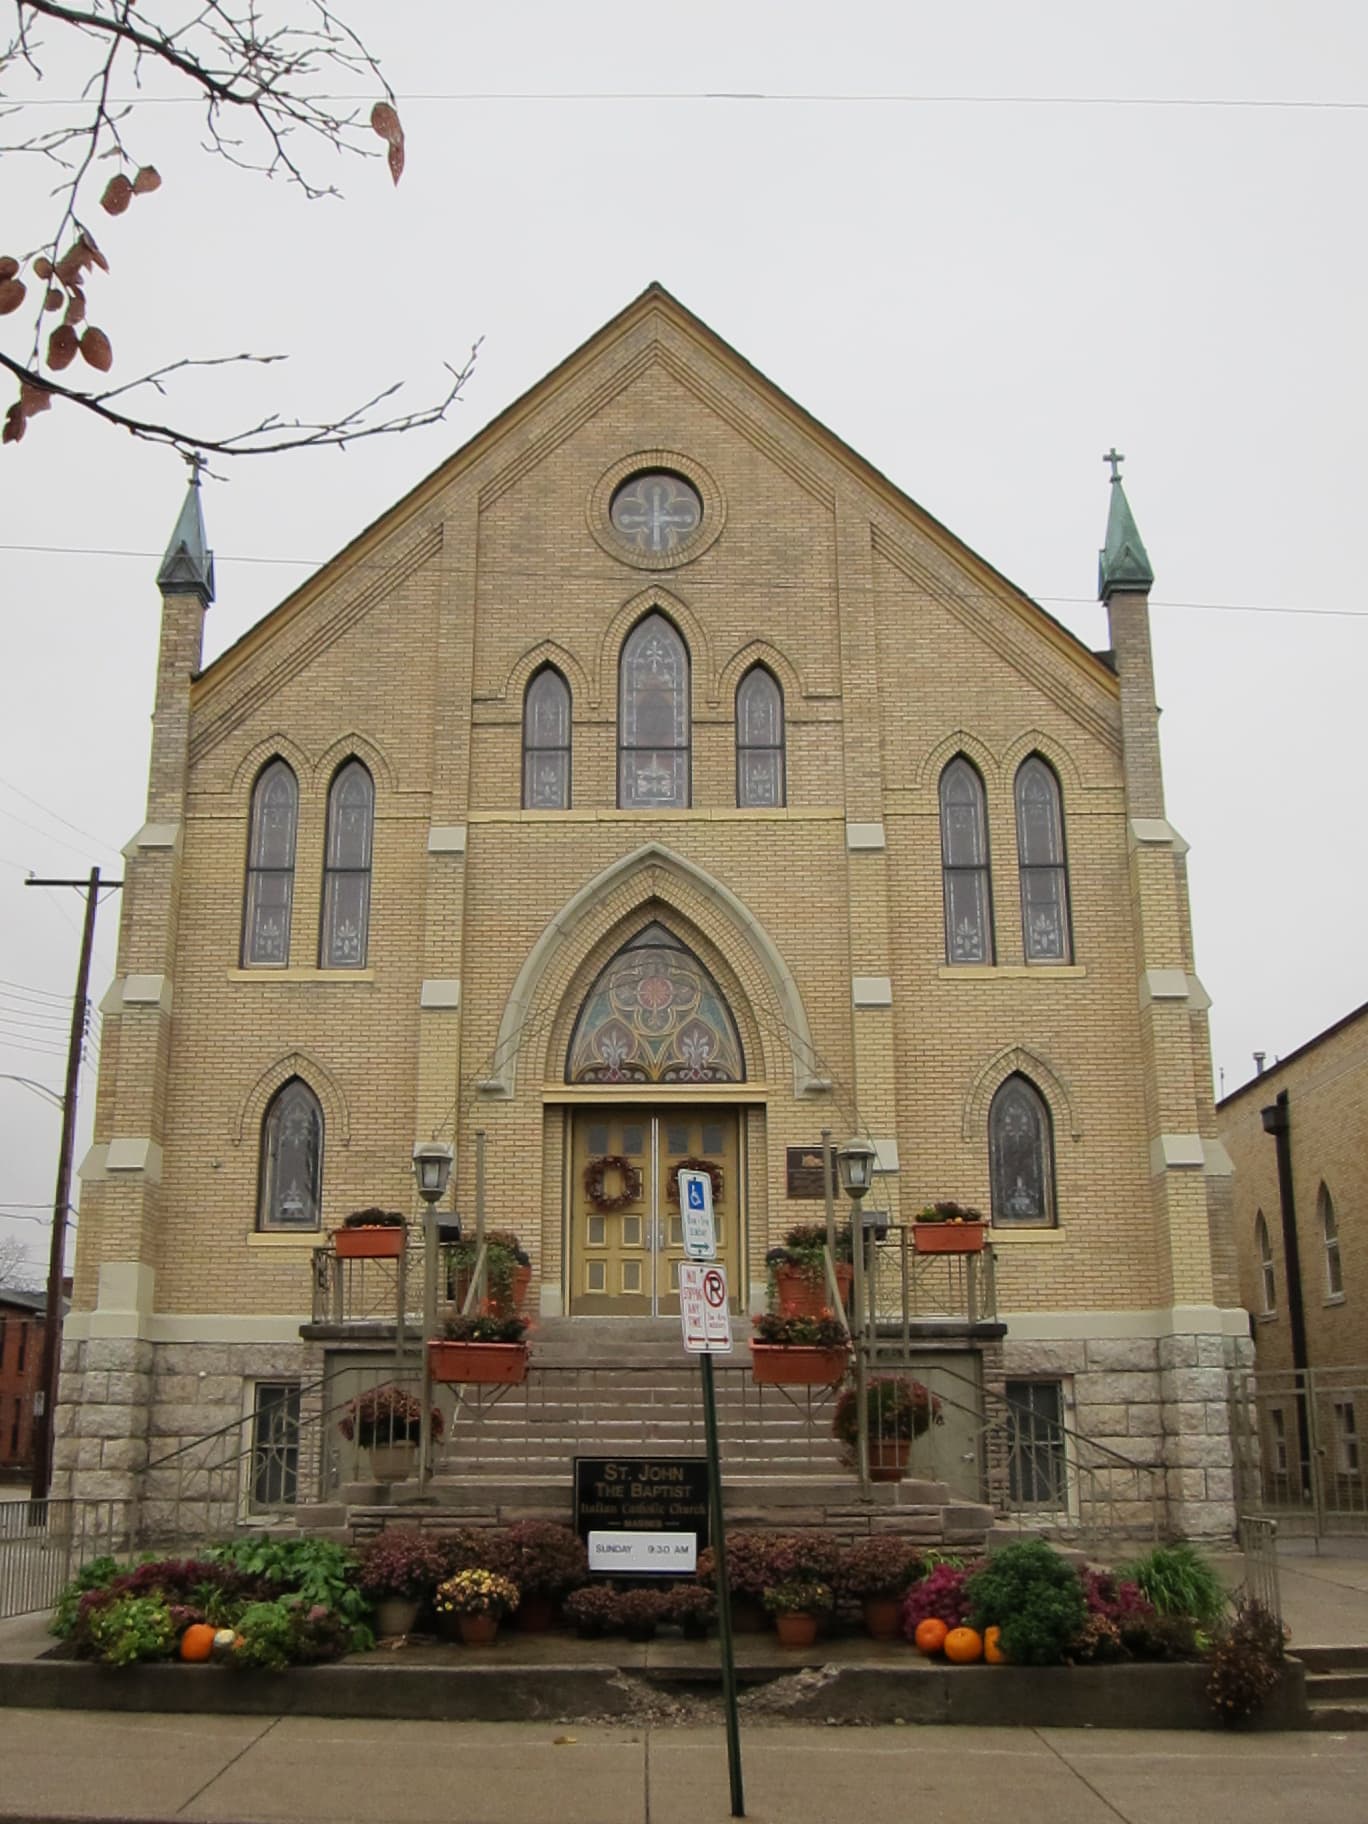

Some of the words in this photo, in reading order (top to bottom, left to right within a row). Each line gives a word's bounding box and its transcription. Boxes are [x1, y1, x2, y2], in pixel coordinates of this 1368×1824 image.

[638, 1463, 684, 1481] JOHN
[594, 1482, 624, 1498] THE
[631, 1482, 692, 1498] BAPTIST
[622, 1502, 665, 1515] Catholic
[669, 1502, 706, 1515] Church
[595, 1543, 633, 1554] SUNDAY
[673, 1544, 689, 1554] AM
